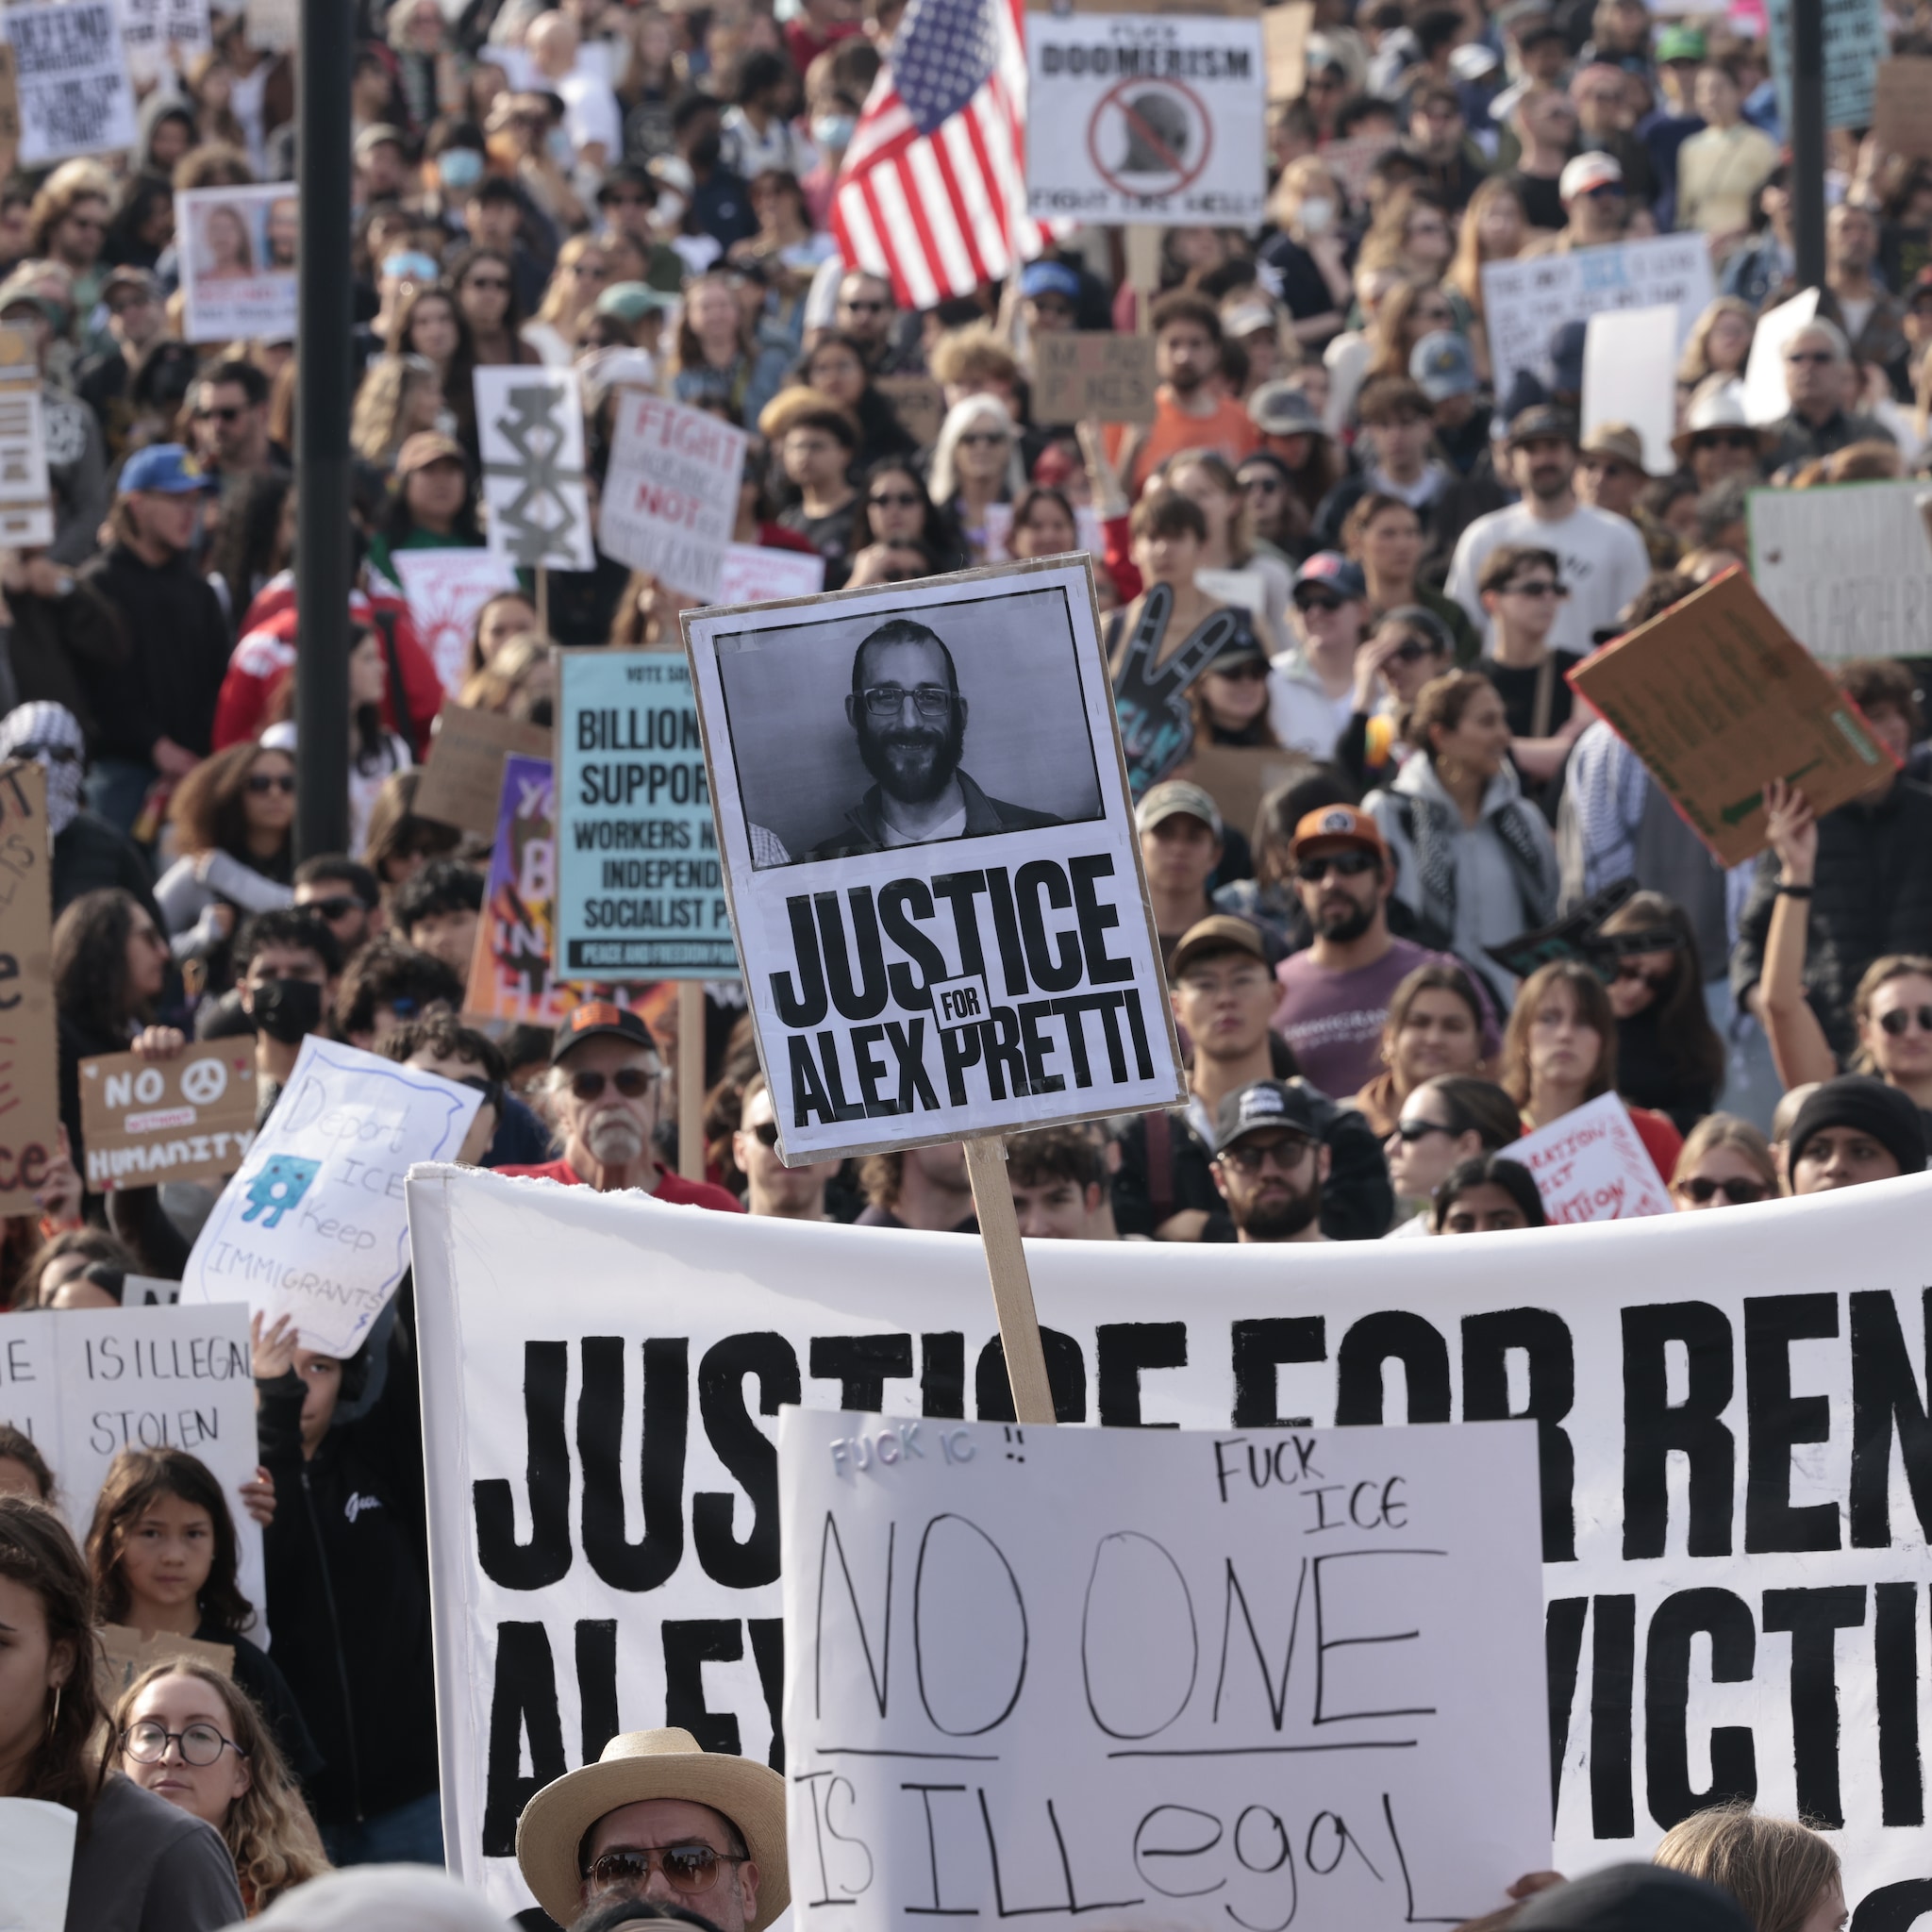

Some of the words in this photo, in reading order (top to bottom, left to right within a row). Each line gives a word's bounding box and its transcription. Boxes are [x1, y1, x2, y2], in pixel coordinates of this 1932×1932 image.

[1041, 43, 1251, 79] DOOMERISM
[635, 398, 740, 471] FIGHT
[634, 482, 702, 529] NOT
[625, 663, 663, 683] VOTE
[578, 708, 701, 752] BILLION
[574, 820, 691, 851] WORKERS
[602, 859, 724, 889] INDEPEND
[584, 898, 705, 929] SOCIALIST
[713, 899, 731, 929] P
[769, 853, 1135, 1028] JUSTICE
[940, 986, 982, 1022] FOR
[787, 1017, 941, 1128] ALEX
[942, 988, 1156, 1108] PRETTI
[105, 1067, 164, 1109] NO
[282, 1075, 412, 1160] Deport
[333, 1158, 408, 1203] ICE
[207, 1241, 384, 1313] IMMIGRANTS
[0, 1338, 36, 1384] E
[85, 1335, 125, 1382] IS
[135, 1335, 254, 1382] ILLEGAL
[90, 1407, 219, 1457] STOLEN
[829, 1422, 924, 1477] FUCK
[1213, 1435, 1324, 1504] FUCK
[1299, 1475, 1408, 1536] ICE
[816, 1510, 1028, 1737] NO
[1080, 1530, 1448, 1740] ONE
[1545, 1582, 1932, 1841] ICTI
[794, 1771, 874, 1907] IS
